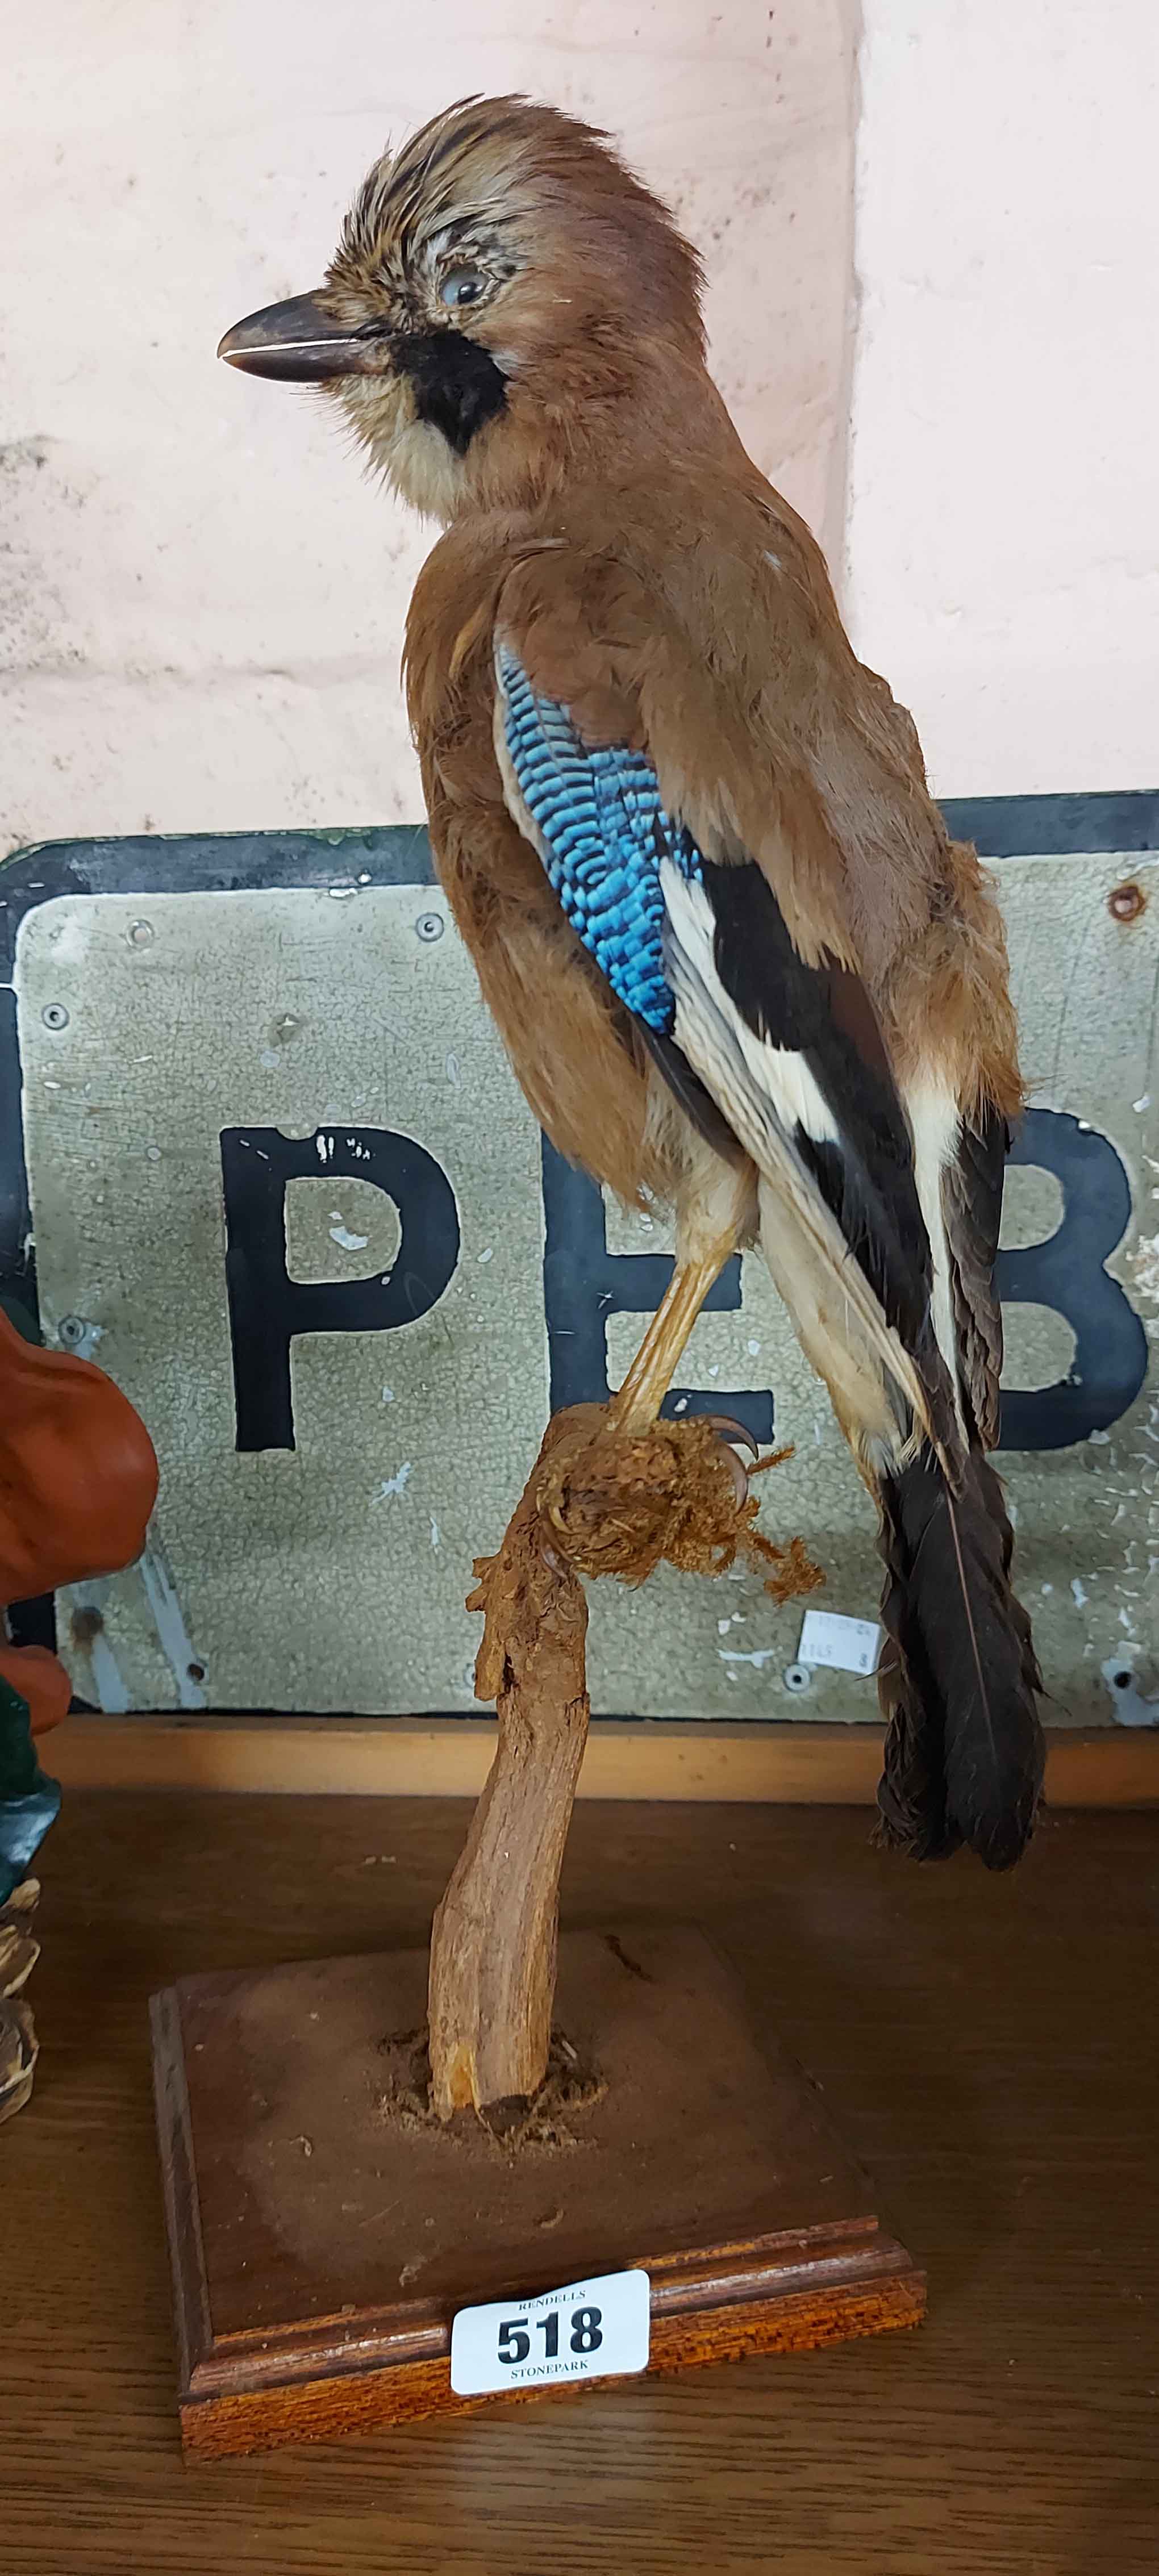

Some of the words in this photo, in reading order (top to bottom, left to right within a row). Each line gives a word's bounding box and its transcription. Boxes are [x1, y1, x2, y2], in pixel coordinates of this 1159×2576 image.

[519, 2290, 586, 2310] RENDELLS
[498, 2306, 603, 2364] 518
[511, 2360, 588, 2379] STONEPARK
